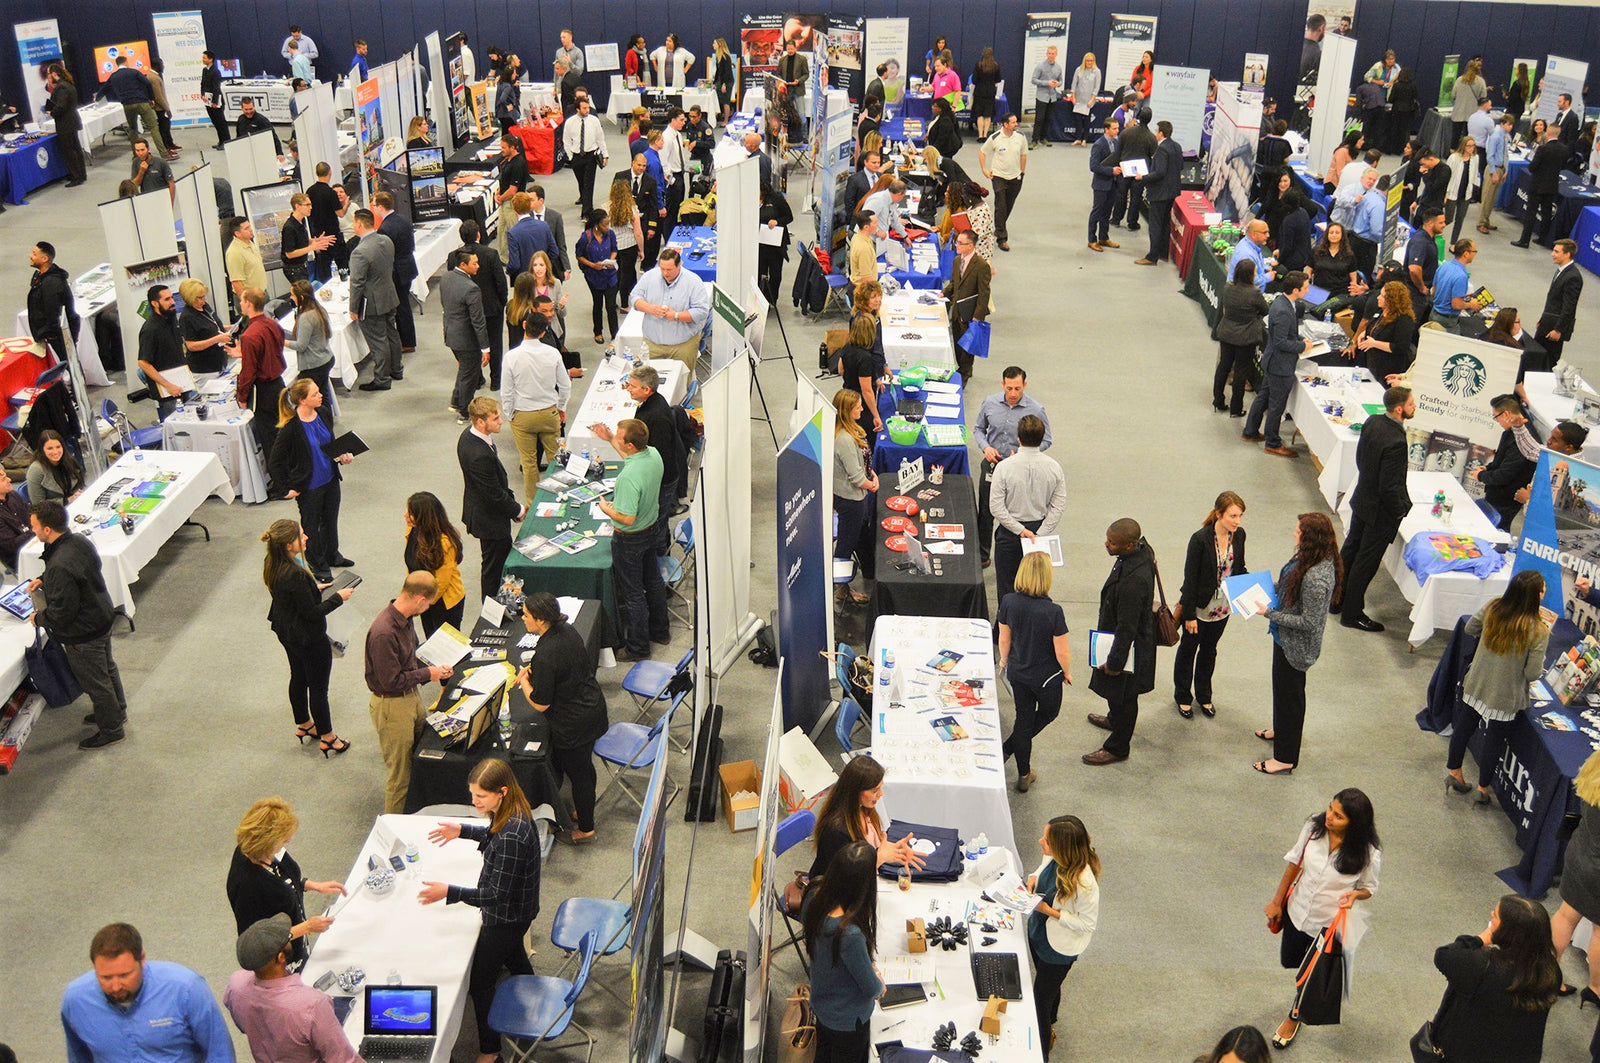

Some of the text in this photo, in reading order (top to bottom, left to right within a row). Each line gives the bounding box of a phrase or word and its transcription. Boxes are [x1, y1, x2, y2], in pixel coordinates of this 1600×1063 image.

[1031, 20, 1066, 31] INTERNSHIPS
[1114, 22, 1152, 34] INTERNSHIPS
[1171, 71, 1196, 80] wayfair
[1420, 393, 1449, 407] Crafted
[1450, 402, 1459, 411] by
[1419, 402, 1495, 430] Ready for anything
[902, 463, 919, 480] BAY
[785, 488, 802, 515] Be you
[785, 489, 816, 531] somewhere
